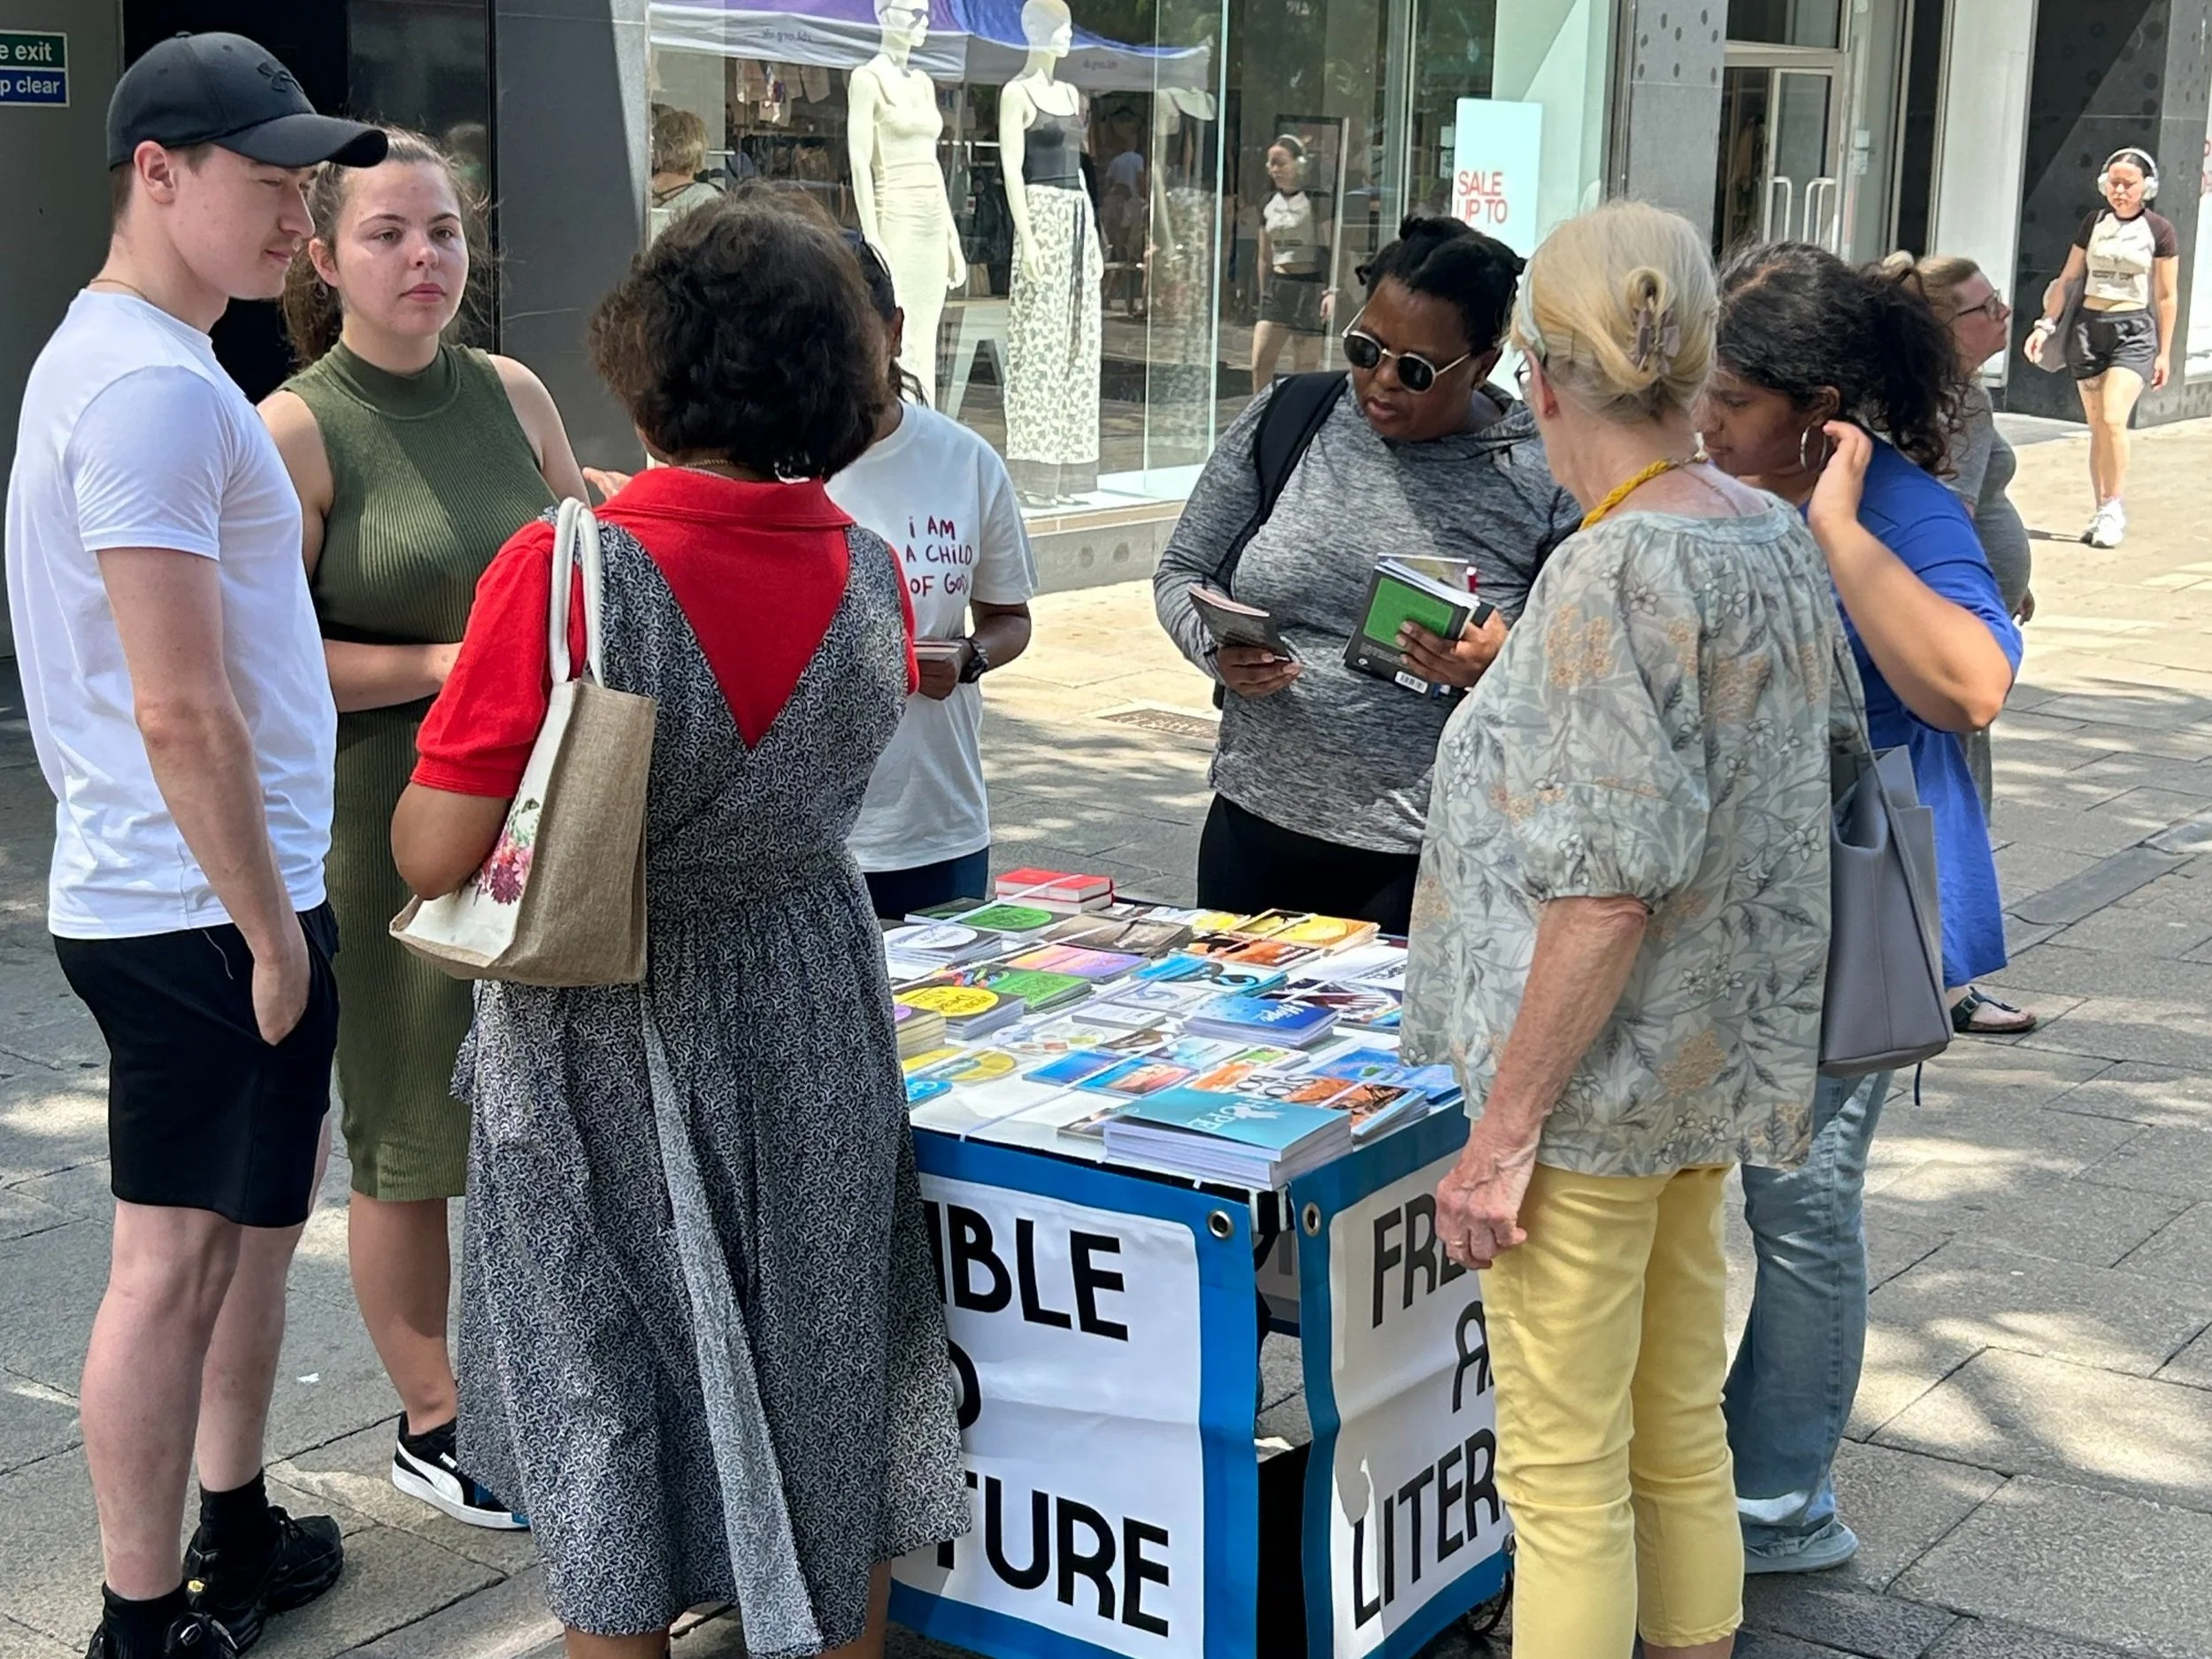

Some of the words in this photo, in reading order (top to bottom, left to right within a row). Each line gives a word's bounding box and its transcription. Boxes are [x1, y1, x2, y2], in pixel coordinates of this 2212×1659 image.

[14, 41, 53, 62] exit
[16, 75, 61, 95] clear
[1457, 169, 1503, 196] SALE
[1485, 199, 1508, 224] TO
[927, 515, 956, 541] AM
[906, 543, 917, 563] A
[910, 575, 935, 597] OF
[1353, 1427, 1502, 1631] LITER
